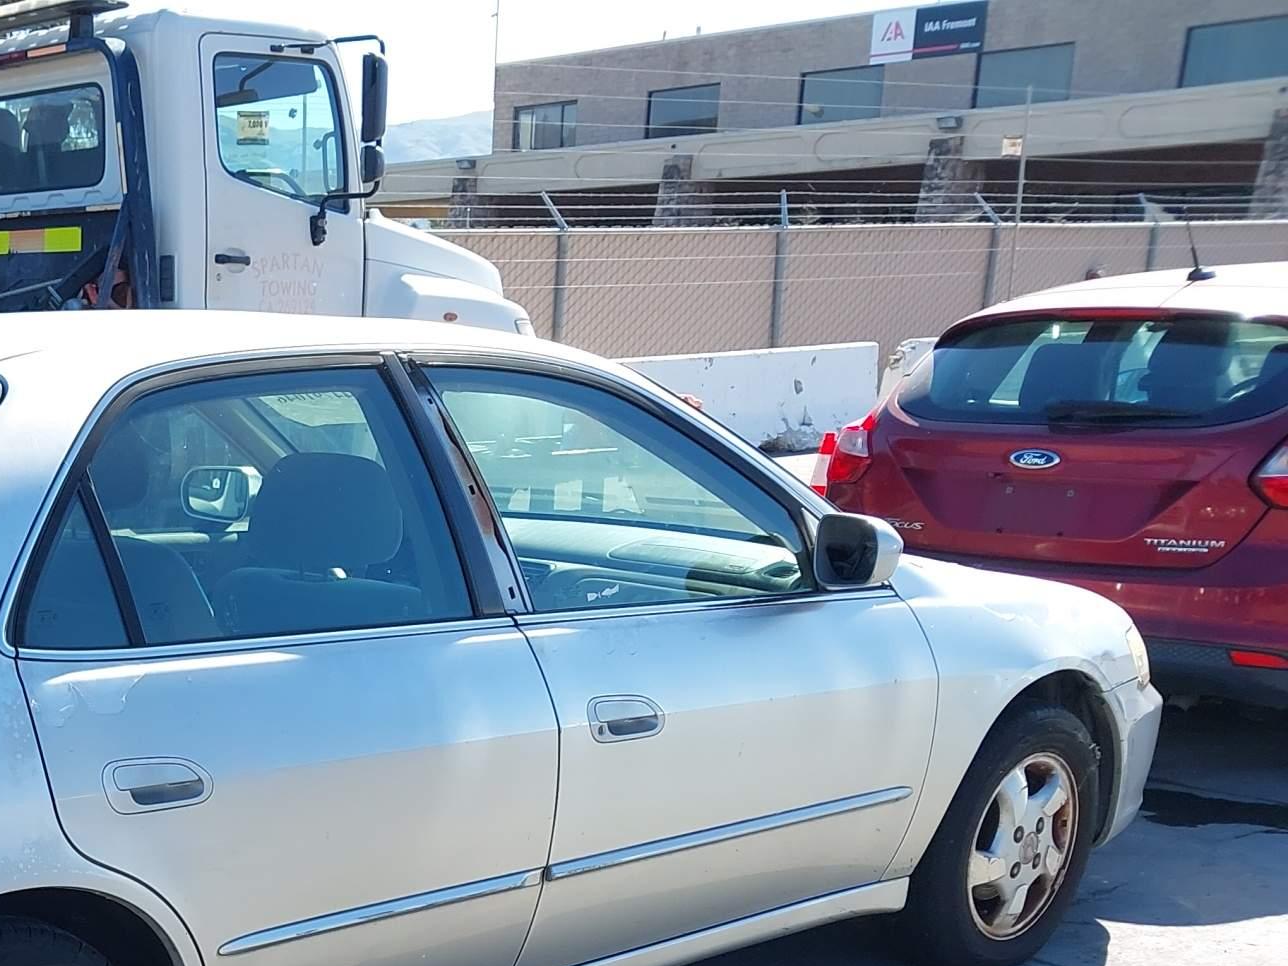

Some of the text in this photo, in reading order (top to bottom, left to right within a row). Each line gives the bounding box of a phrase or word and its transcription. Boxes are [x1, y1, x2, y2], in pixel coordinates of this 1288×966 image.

[924, 18, 977, 32] IAA Fremont
[252, 252, 324, 279] SPARTAN
[259, 280, 317, 297] TOWING
[1019, 453, 1047, 465] Ford
[1143, 538, 1226, 547] TITANIUM
